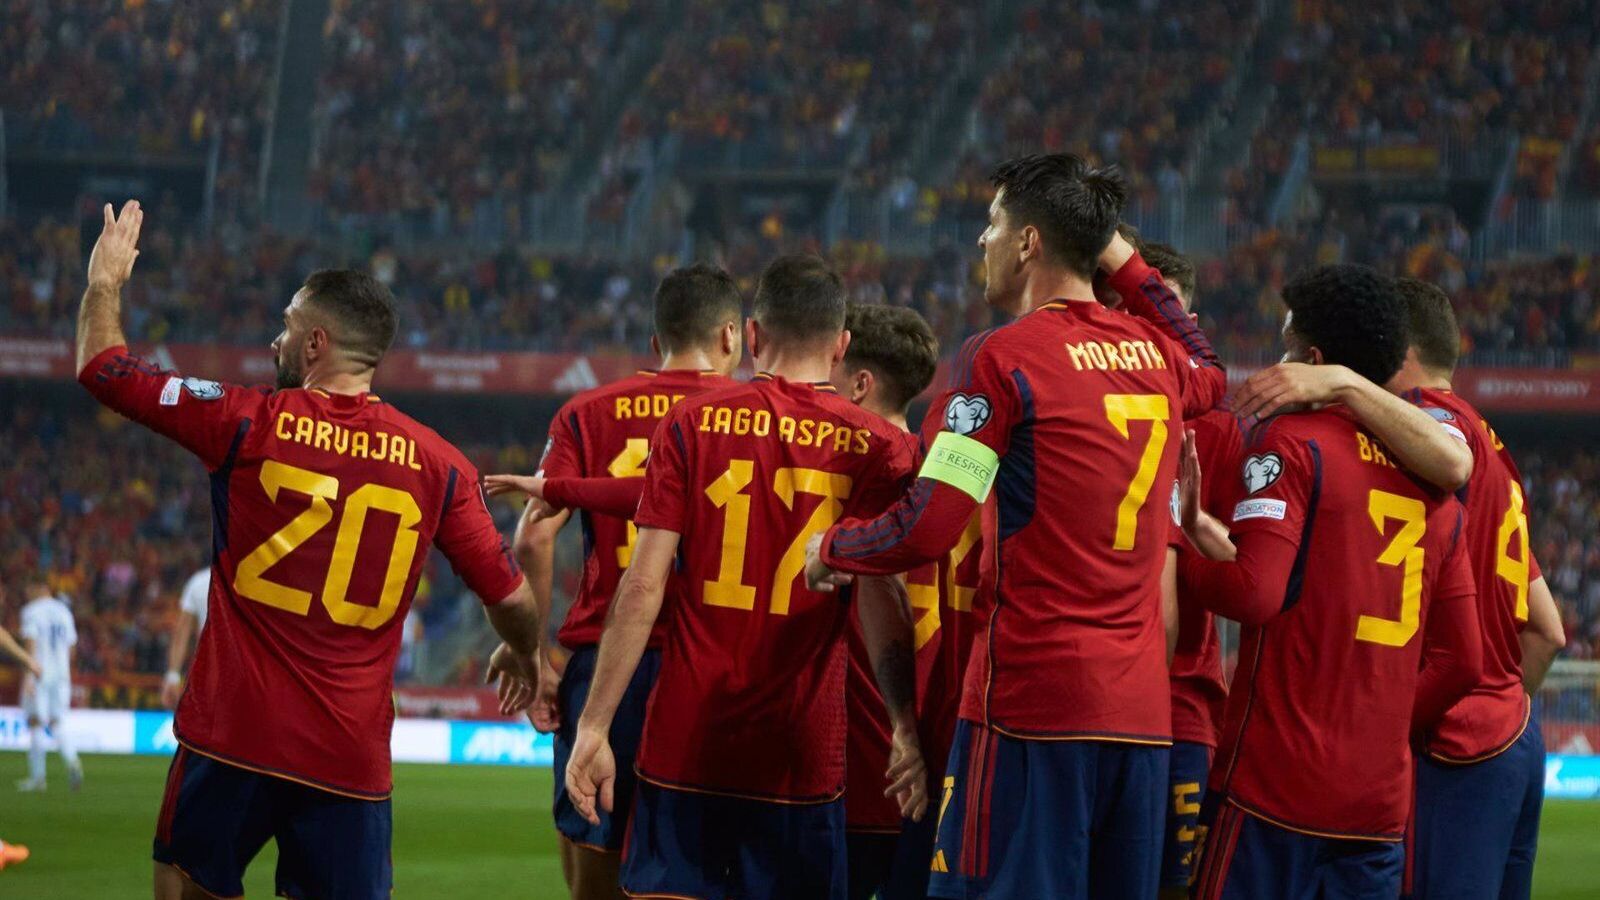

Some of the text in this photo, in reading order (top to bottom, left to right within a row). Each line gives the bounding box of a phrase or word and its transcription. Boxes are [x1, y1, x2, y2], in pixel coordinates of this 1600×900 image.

[615, 394, 685, 419] ROD
[1066, 340, 1167, 371] MORATA
[275, 411, 422, 471] CARVAJAL
[699, 406, 872, 455] IAGO ASPAS
[1103, 393, 1170, 551] 7
[233, 459, 423, 630] 20
[704, 459, 853, 615] 17
[1355, 488, 1427, 647] 3
[1496, 479, 1530, 622] 4
